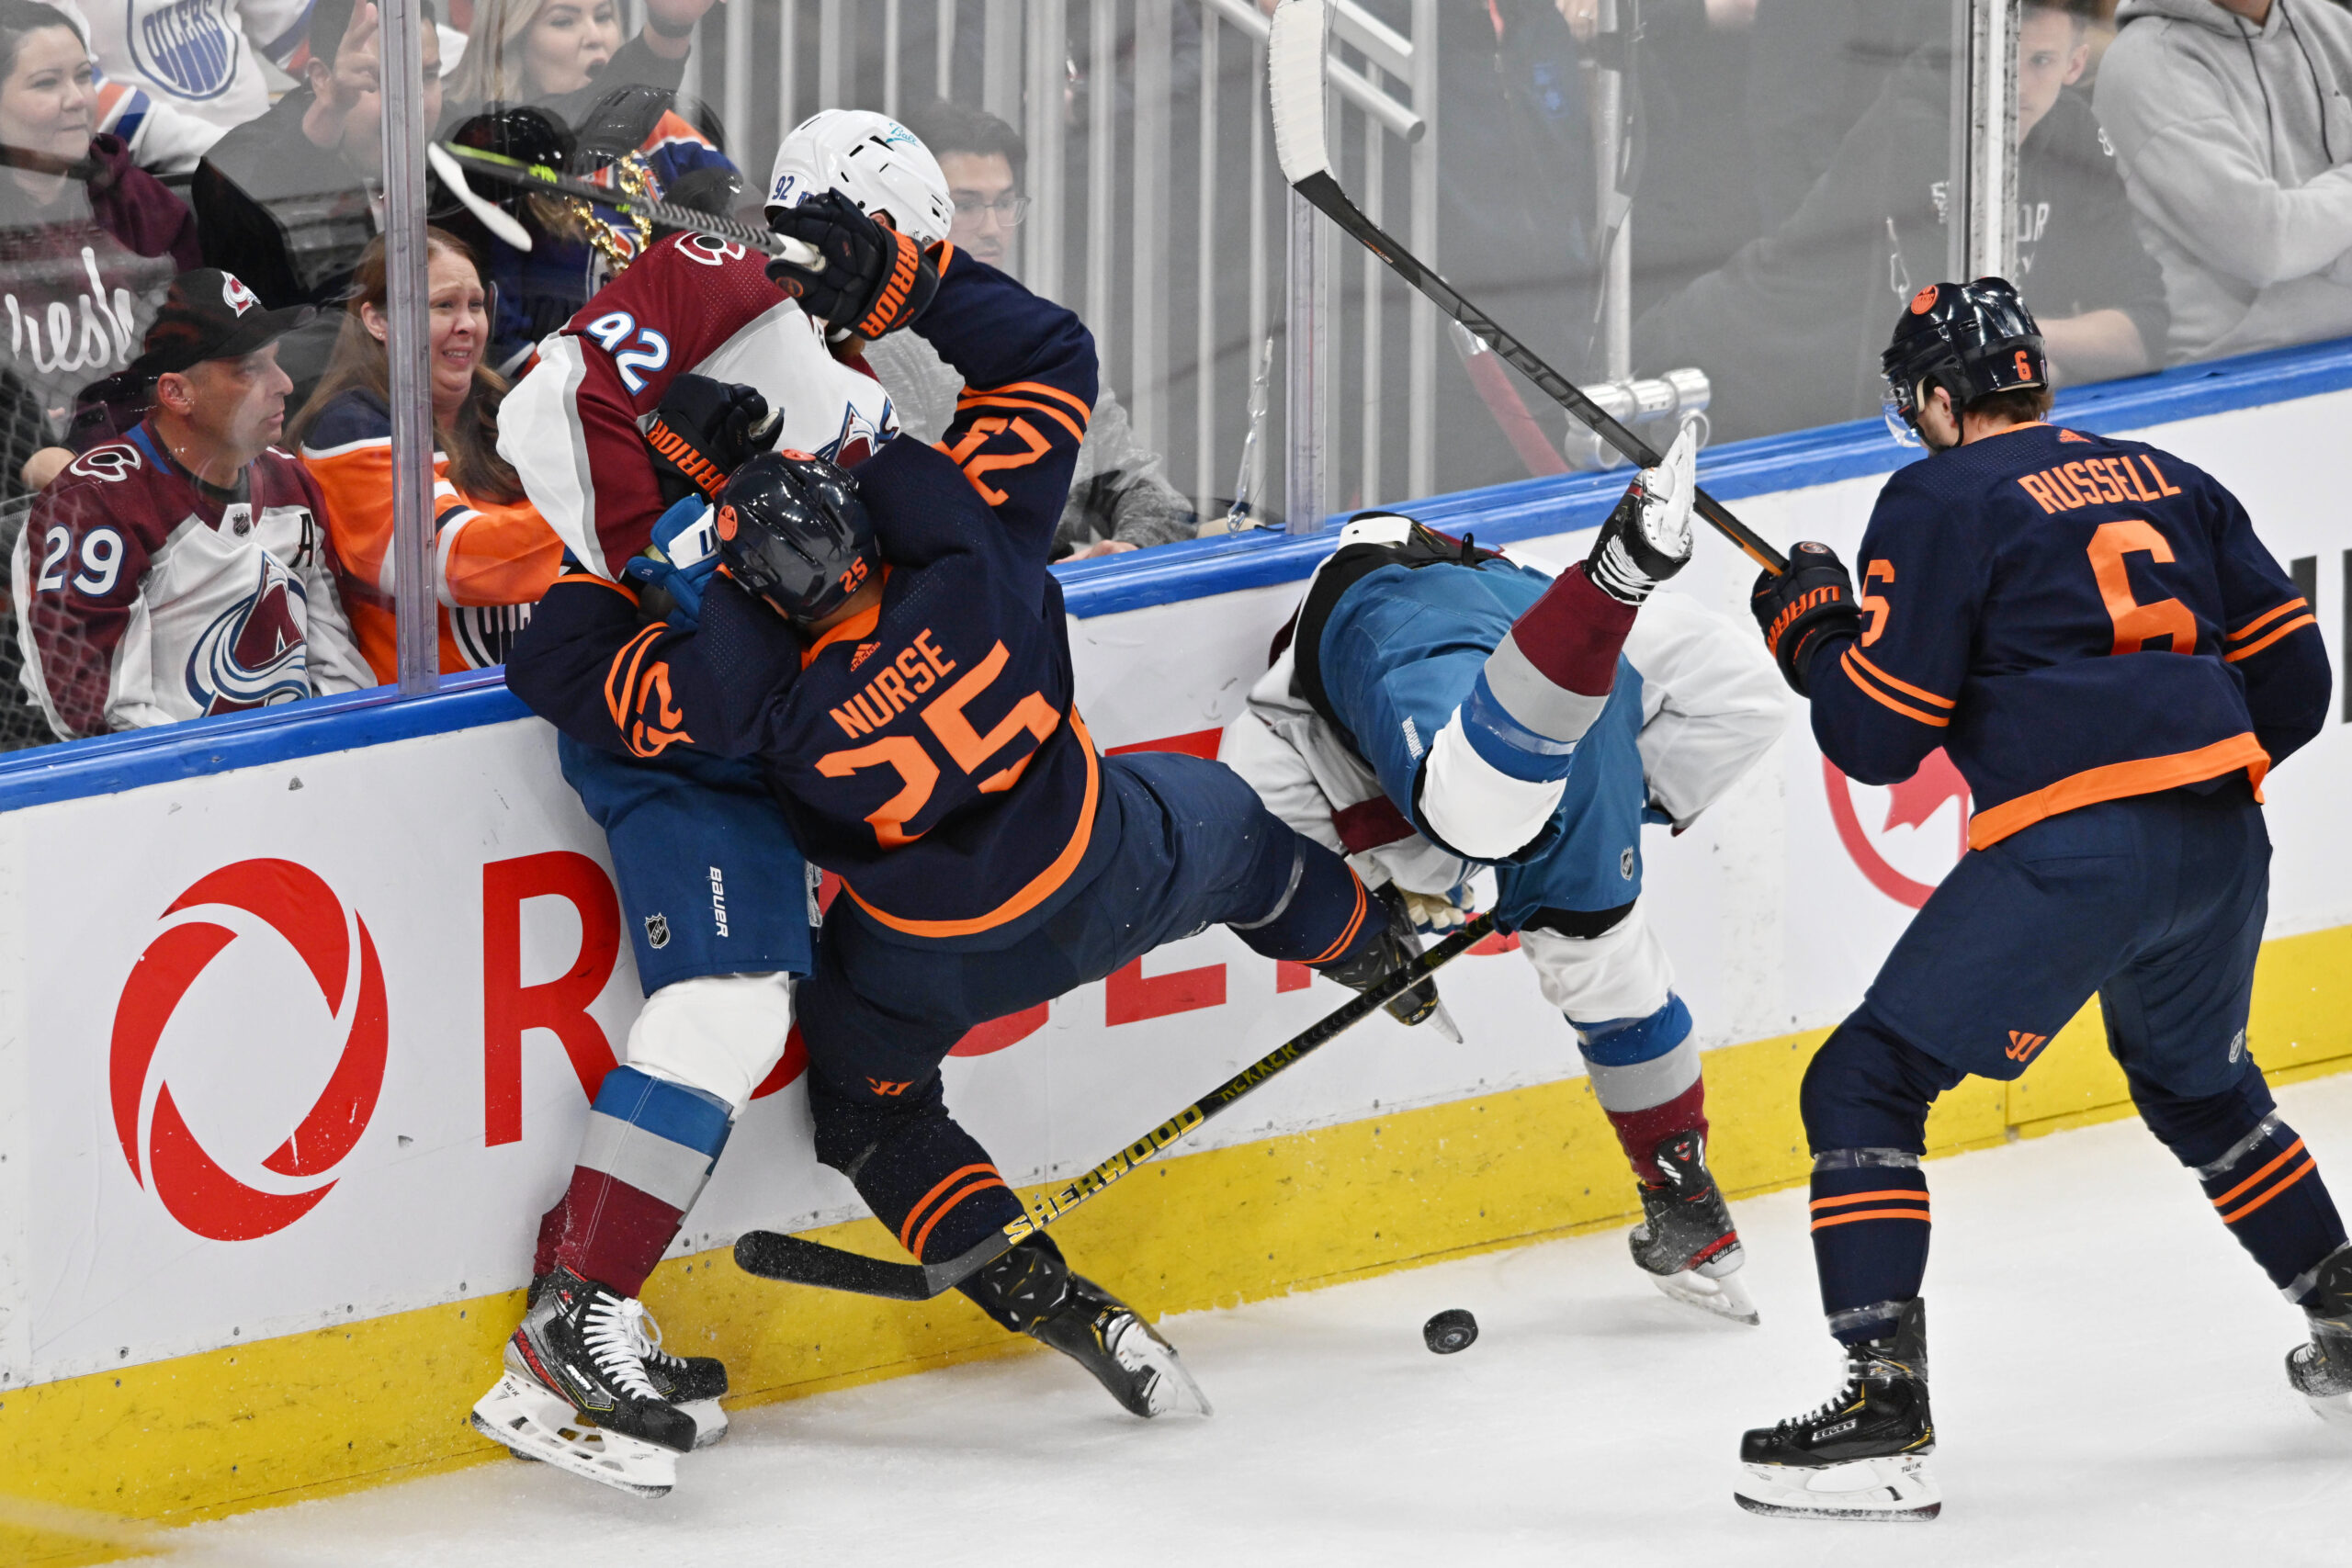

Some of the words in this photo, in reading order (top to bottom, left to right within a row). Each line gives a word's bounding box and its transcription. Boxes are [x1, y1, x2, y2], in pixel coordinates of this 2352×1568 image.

[772, 175, 795, 201] 92
[858, 230, 919, 337] RRIOR
[586, 310, 670, 397] 92
[2014, 350, 2032, 380] 6
[645, 419, 732, 501] RRIOR
[2017, 454, 2182, 514] RUSSELL
[38, 523, 126, 597] 29
[287, 513, 315, 568] A
[838, 556, 868, 593] 25
[1860, 558, 1895, 648] 6
[2086, 519, 2198, 656] 6
[829, 627, 956, 739] NURSE
[814, 638, 1061, 852] 25
[1003, 1104, 1203, 1245] SHERWOOD
